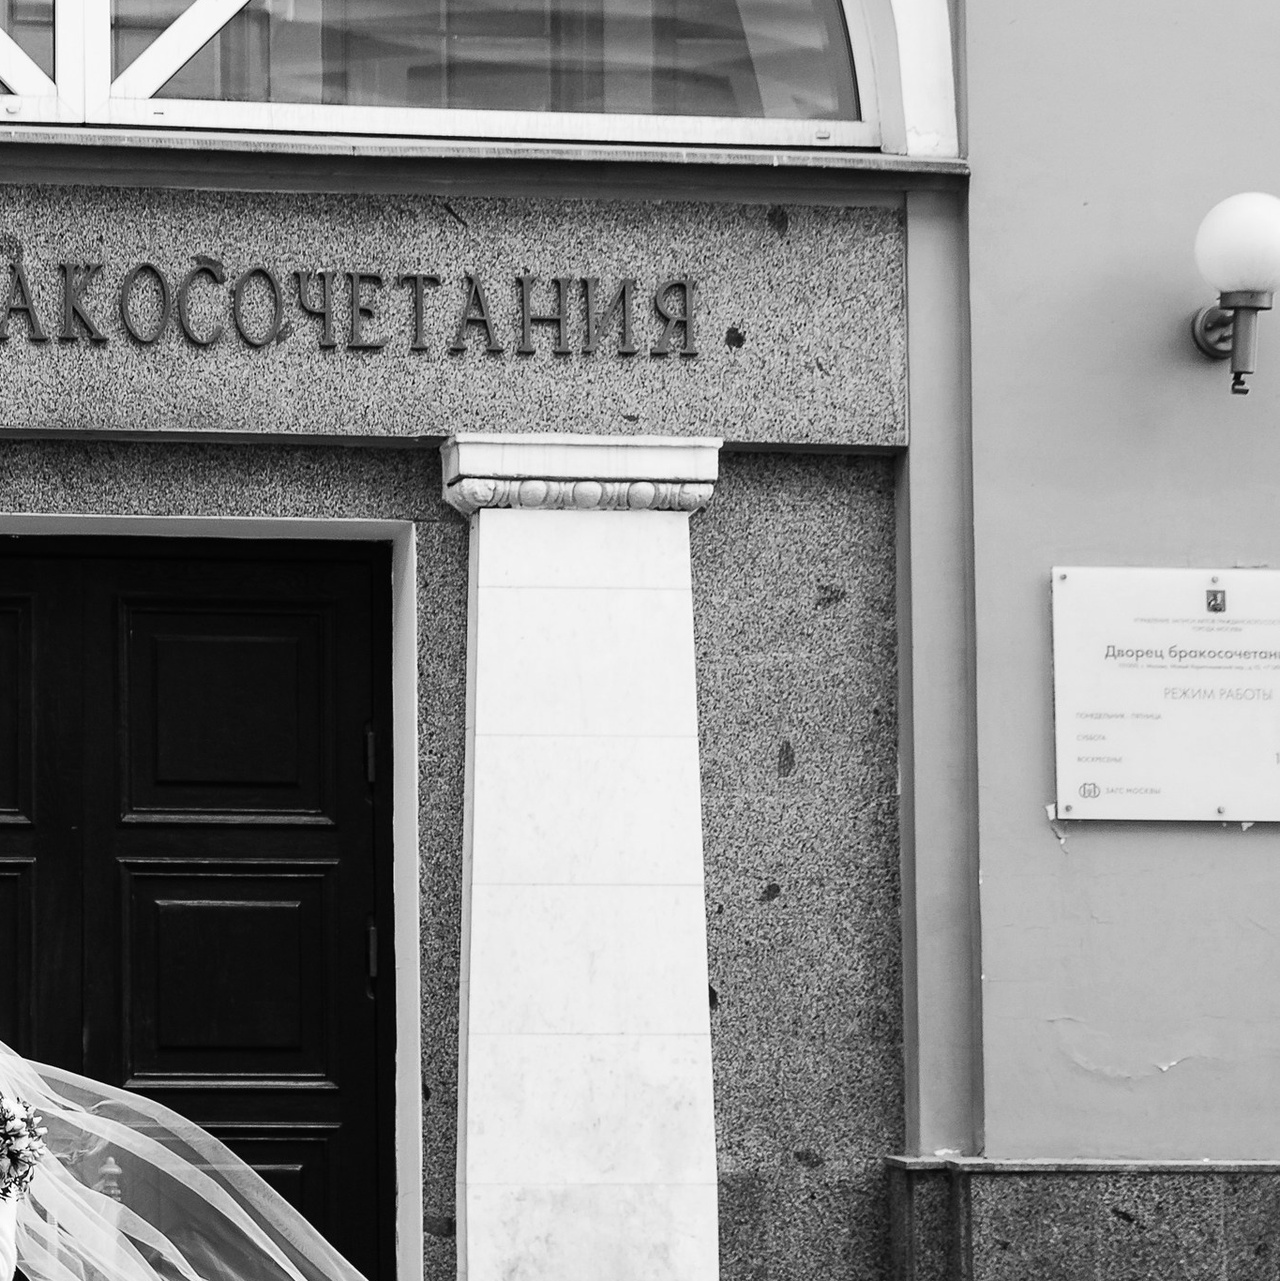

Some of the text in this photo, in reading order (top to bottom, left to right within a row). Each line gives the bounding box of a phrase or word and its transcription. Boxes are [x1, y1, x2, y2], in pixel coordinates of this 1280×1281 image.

[1104, 644, 1165, 661] Дворец
[1163, 686, 1273, 701] РЕЖИМ РАБОТЫ
